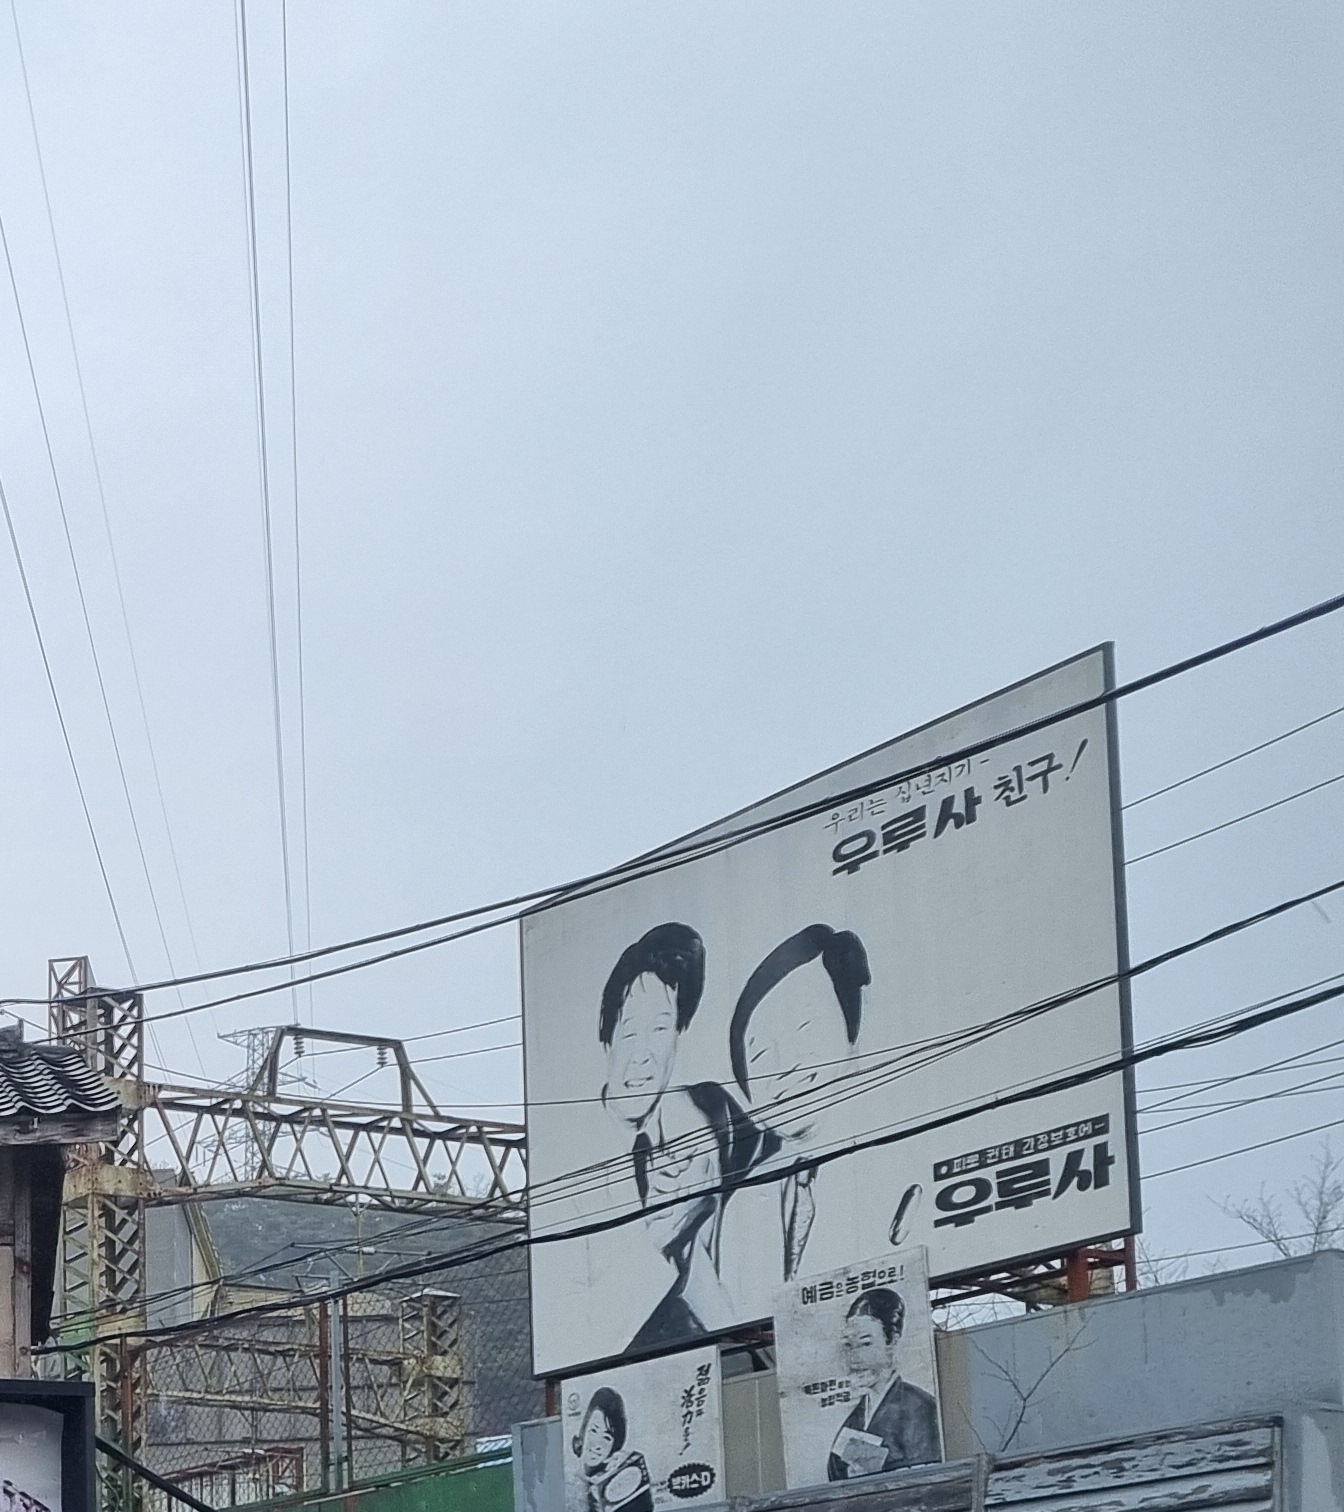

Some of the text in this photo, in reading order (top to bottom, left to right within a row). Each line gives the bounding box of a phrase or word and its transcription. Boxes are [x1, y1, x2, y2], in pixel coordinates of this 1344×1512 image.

[823, 798, 888, 834] 우리는
[831, 738, 1090, 877] 우루사 친구!
[932, 1140, 1116, 1229] 우루사
